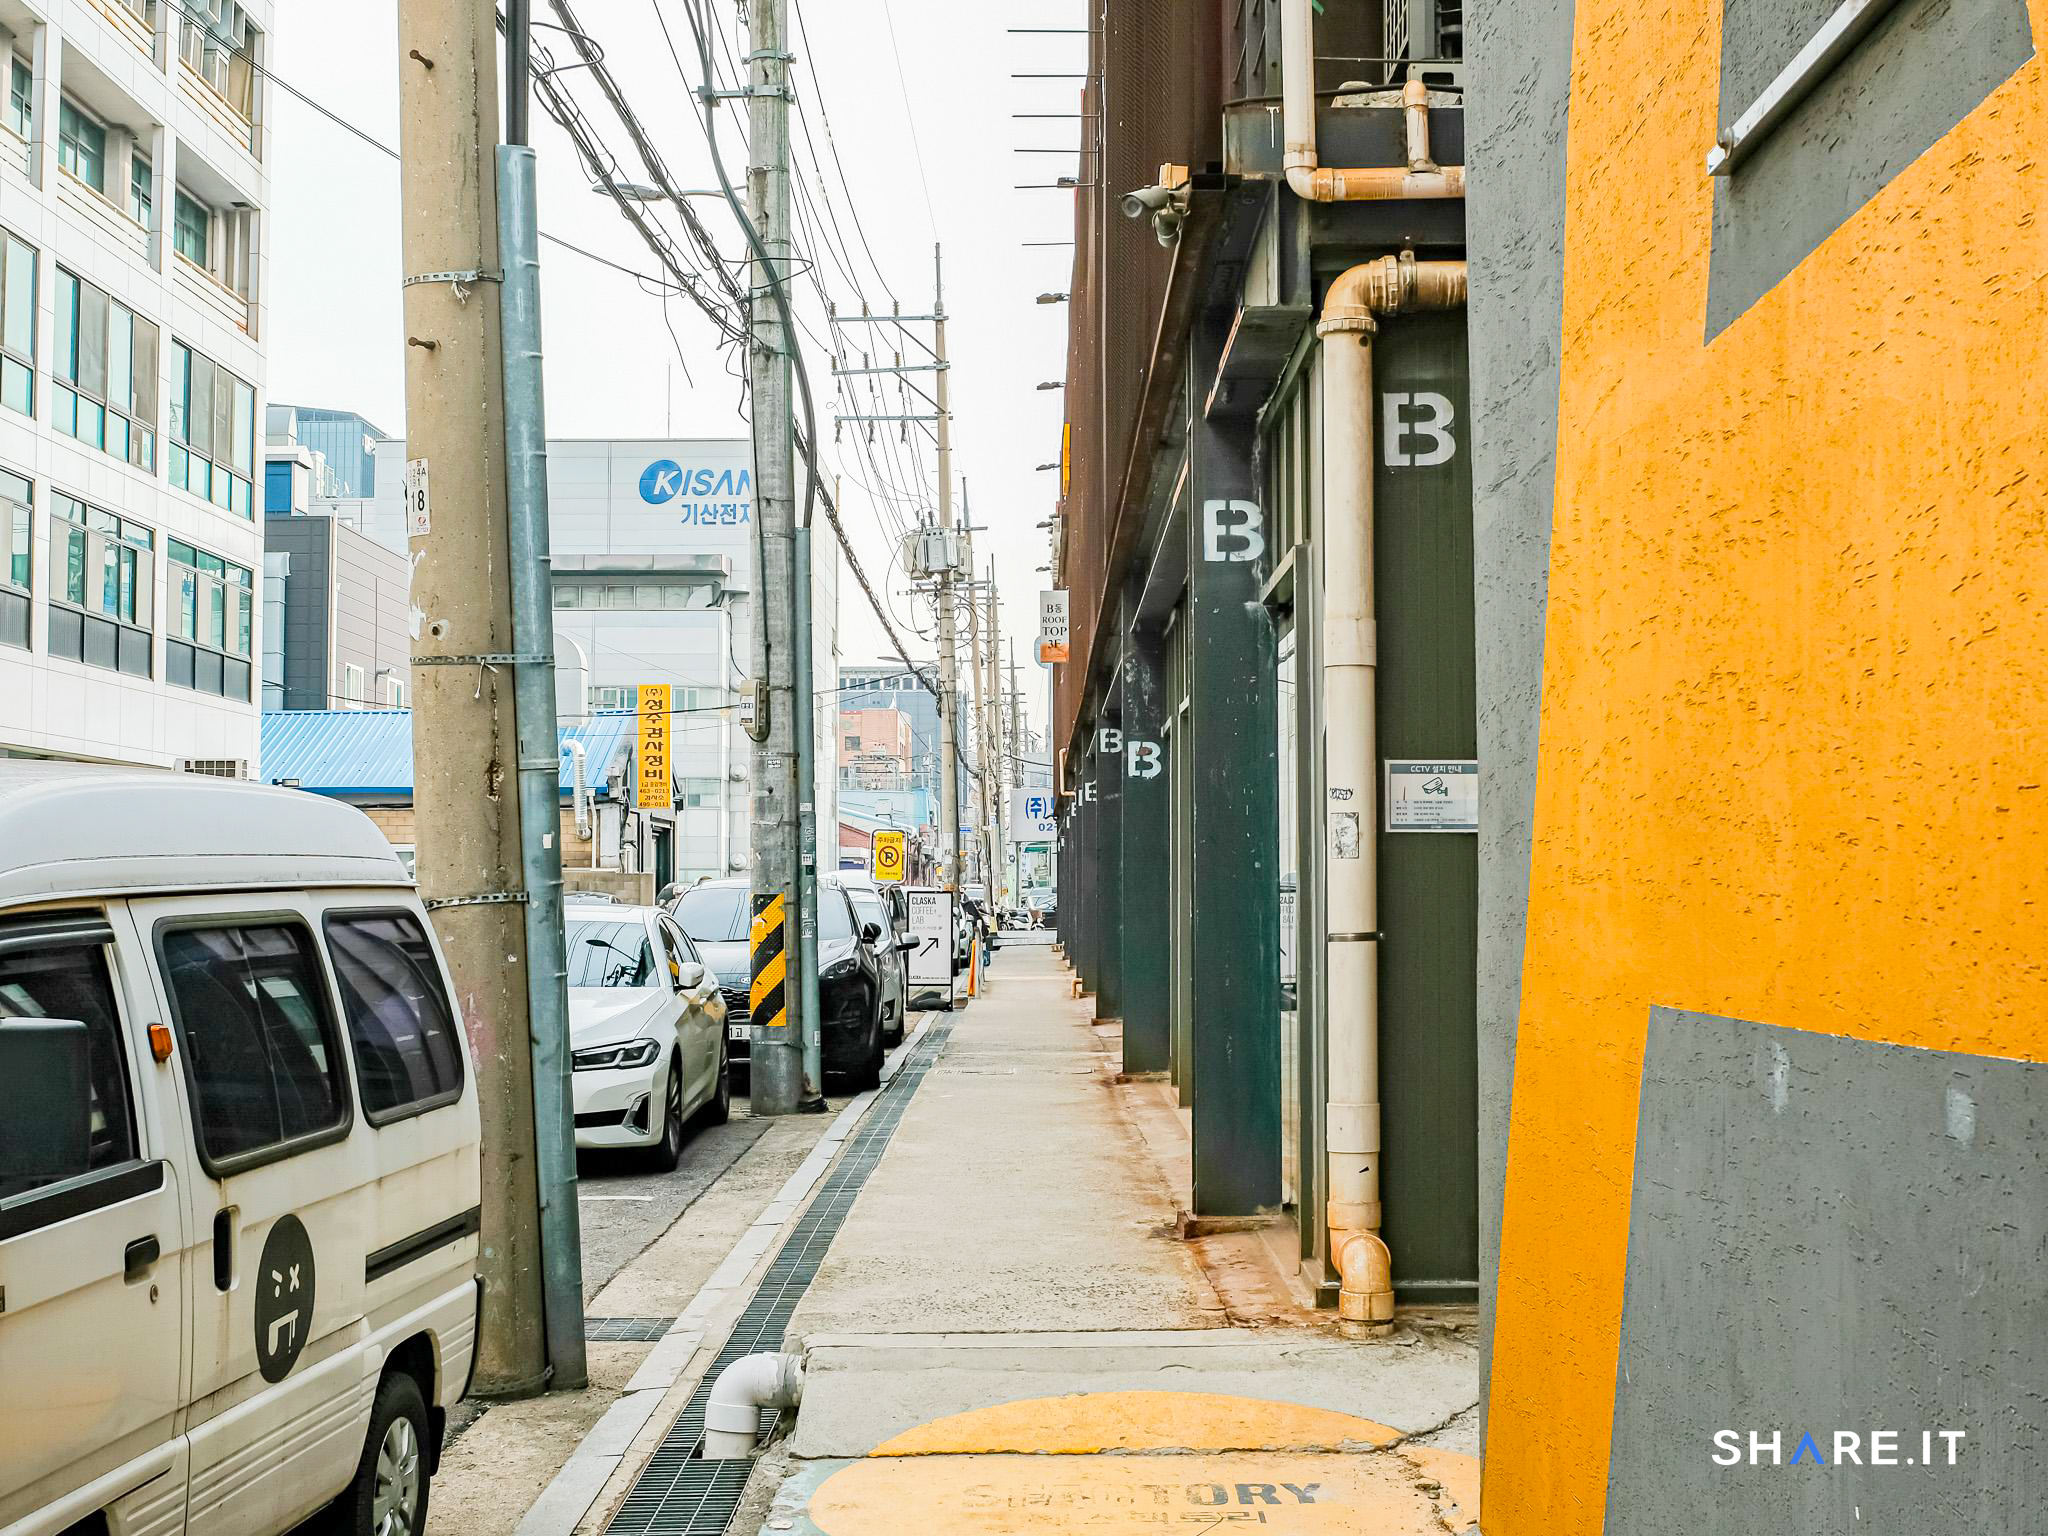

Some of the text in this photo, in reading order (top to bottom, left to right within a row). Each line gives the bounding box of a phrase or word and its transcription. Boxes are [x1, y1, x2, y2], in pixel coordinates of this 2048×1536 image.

[1383, 392, 1456, 467] B
[411, 489, 425, 512] 18
[1203, 500, 1265, 562] B
[1042, 626, 1068, 636] TOP
[1100, 728, 1123, 753] B
[1127, 740, 1162, 780] B
[1410, 765, 1431, 773] CCTV
[1025, 797, 1054, 819] (주)
[911, 896, 936, 905] CLASKA
